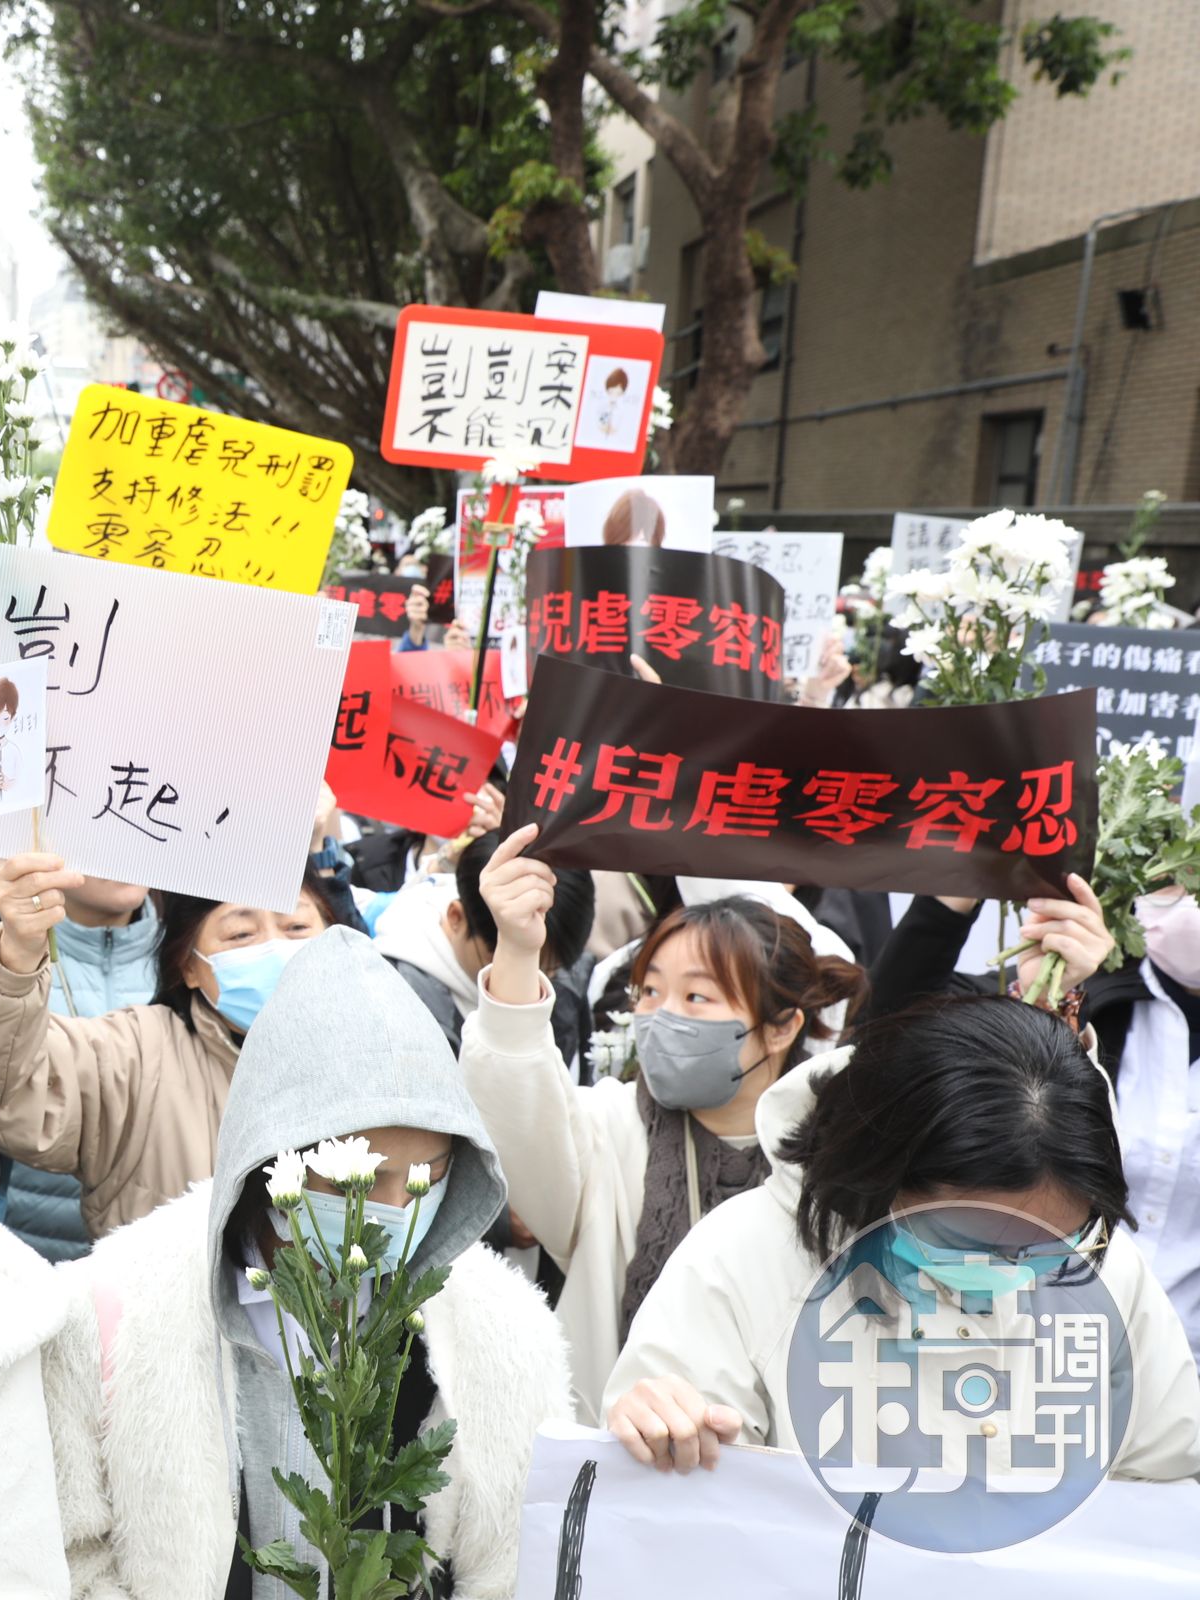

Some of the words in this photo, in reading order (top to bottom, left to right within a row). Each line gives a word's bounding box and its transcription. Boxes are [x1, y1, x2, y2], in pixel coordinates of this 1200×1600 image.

[419, 333, 577, 409] 剴剴案
[532, 735, 1079, 858] #兒虐零容忍
